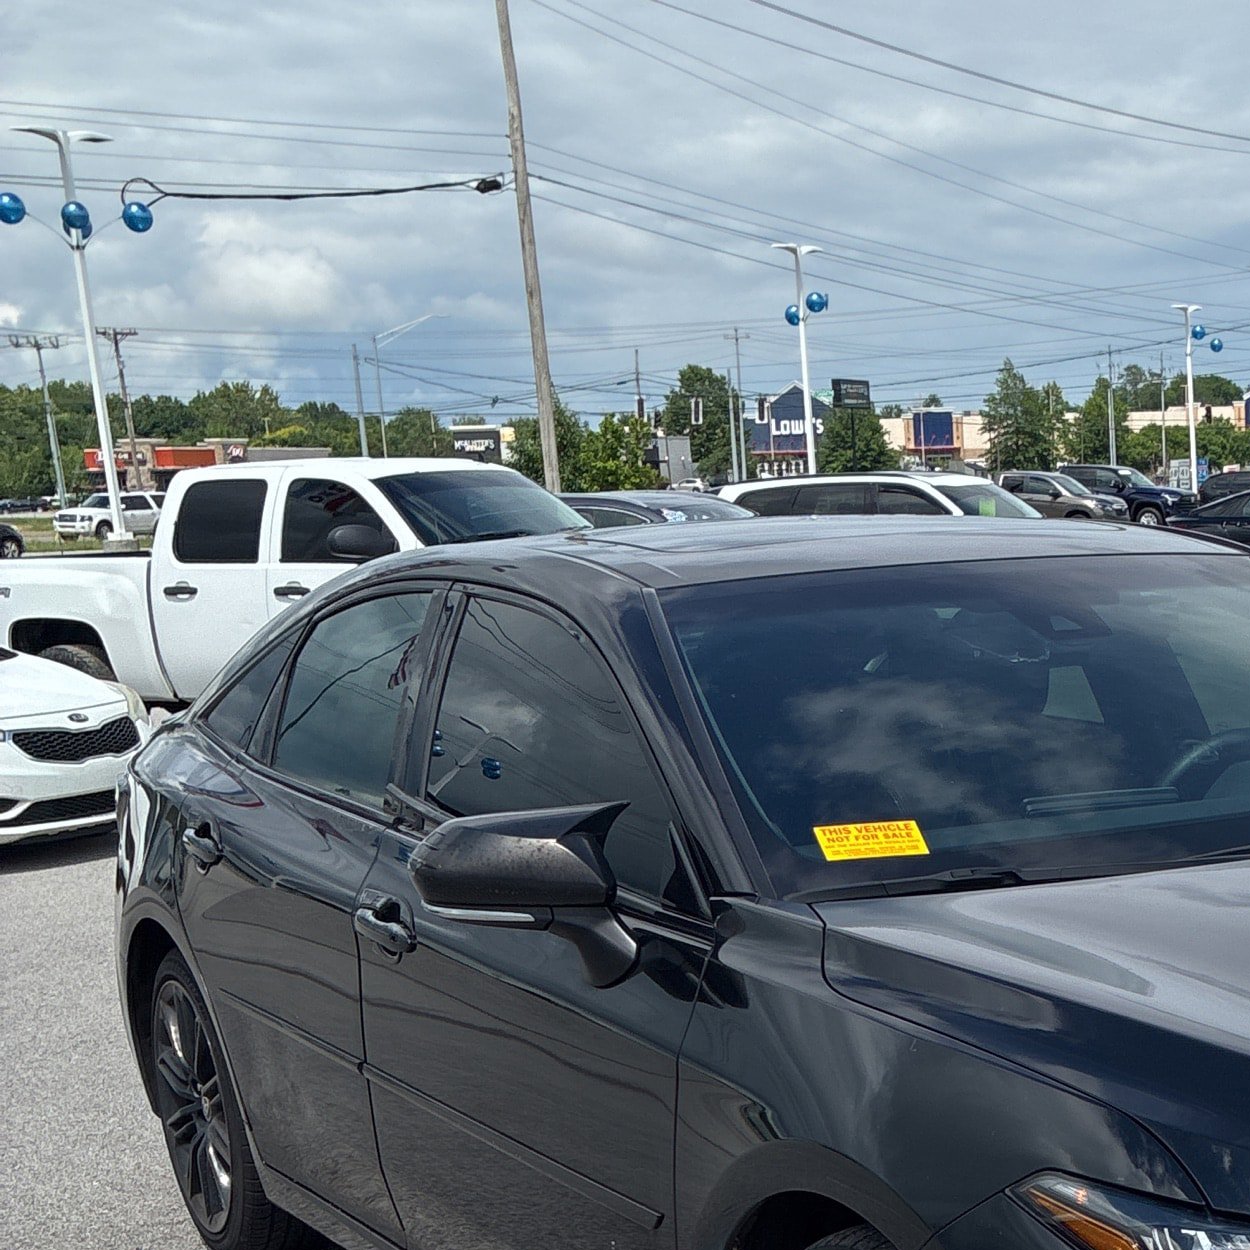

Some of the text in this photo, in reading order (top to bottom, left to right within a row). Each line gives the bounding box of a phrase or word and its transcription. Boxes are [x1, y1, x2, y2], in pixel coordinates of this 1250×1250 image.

[771, 418, 825, 436] LOW'S
[819, 822, 913, 837] THIS VEHICLE
[826, 836, 851, 844] NOT
[854, 833, 879, 842] FOR
[882, 831, 914, 840] SALE
